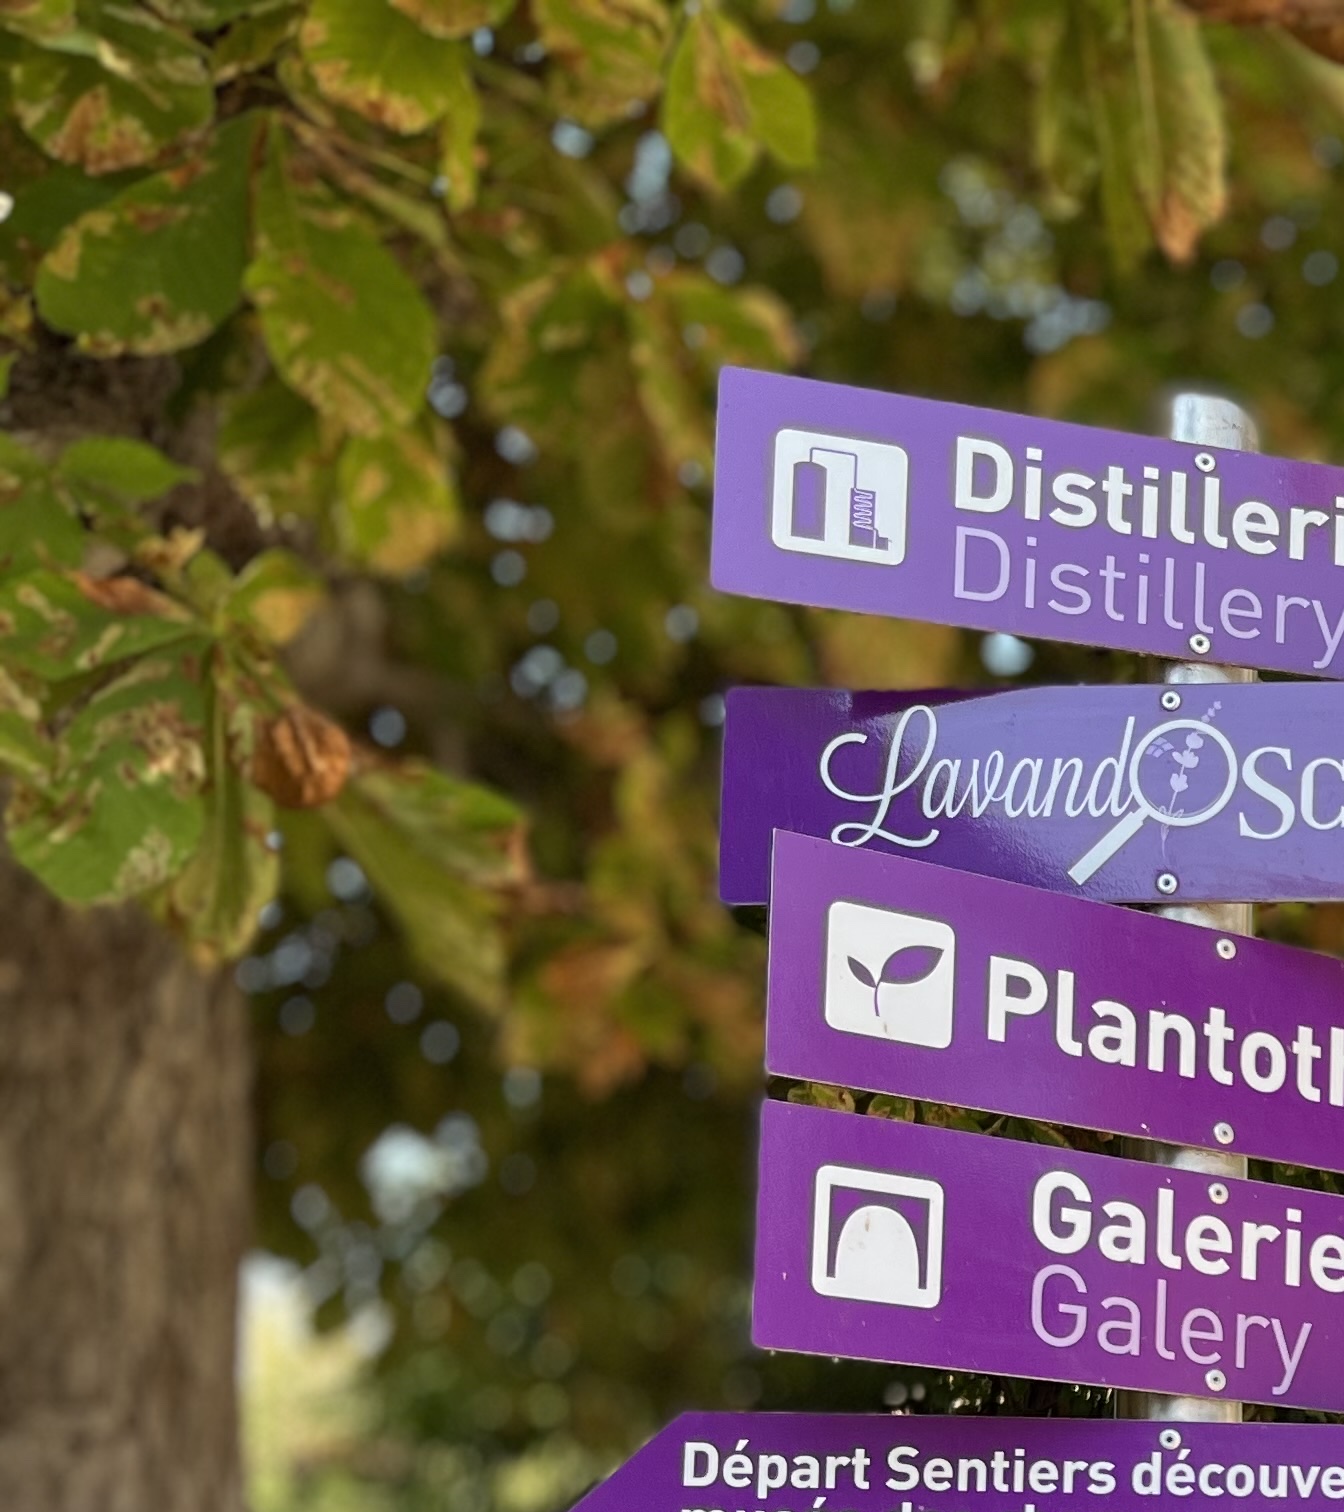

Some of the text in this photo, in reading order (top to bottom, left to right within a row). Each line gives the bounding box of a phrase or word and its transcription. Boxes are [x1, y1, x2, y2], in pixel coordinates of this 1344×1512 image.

[1031, 1265, 1312, 1396] Galery
[682, 1438, 871, 1499] Départ
[885, 1446, 1117, 1494] Sentiers
